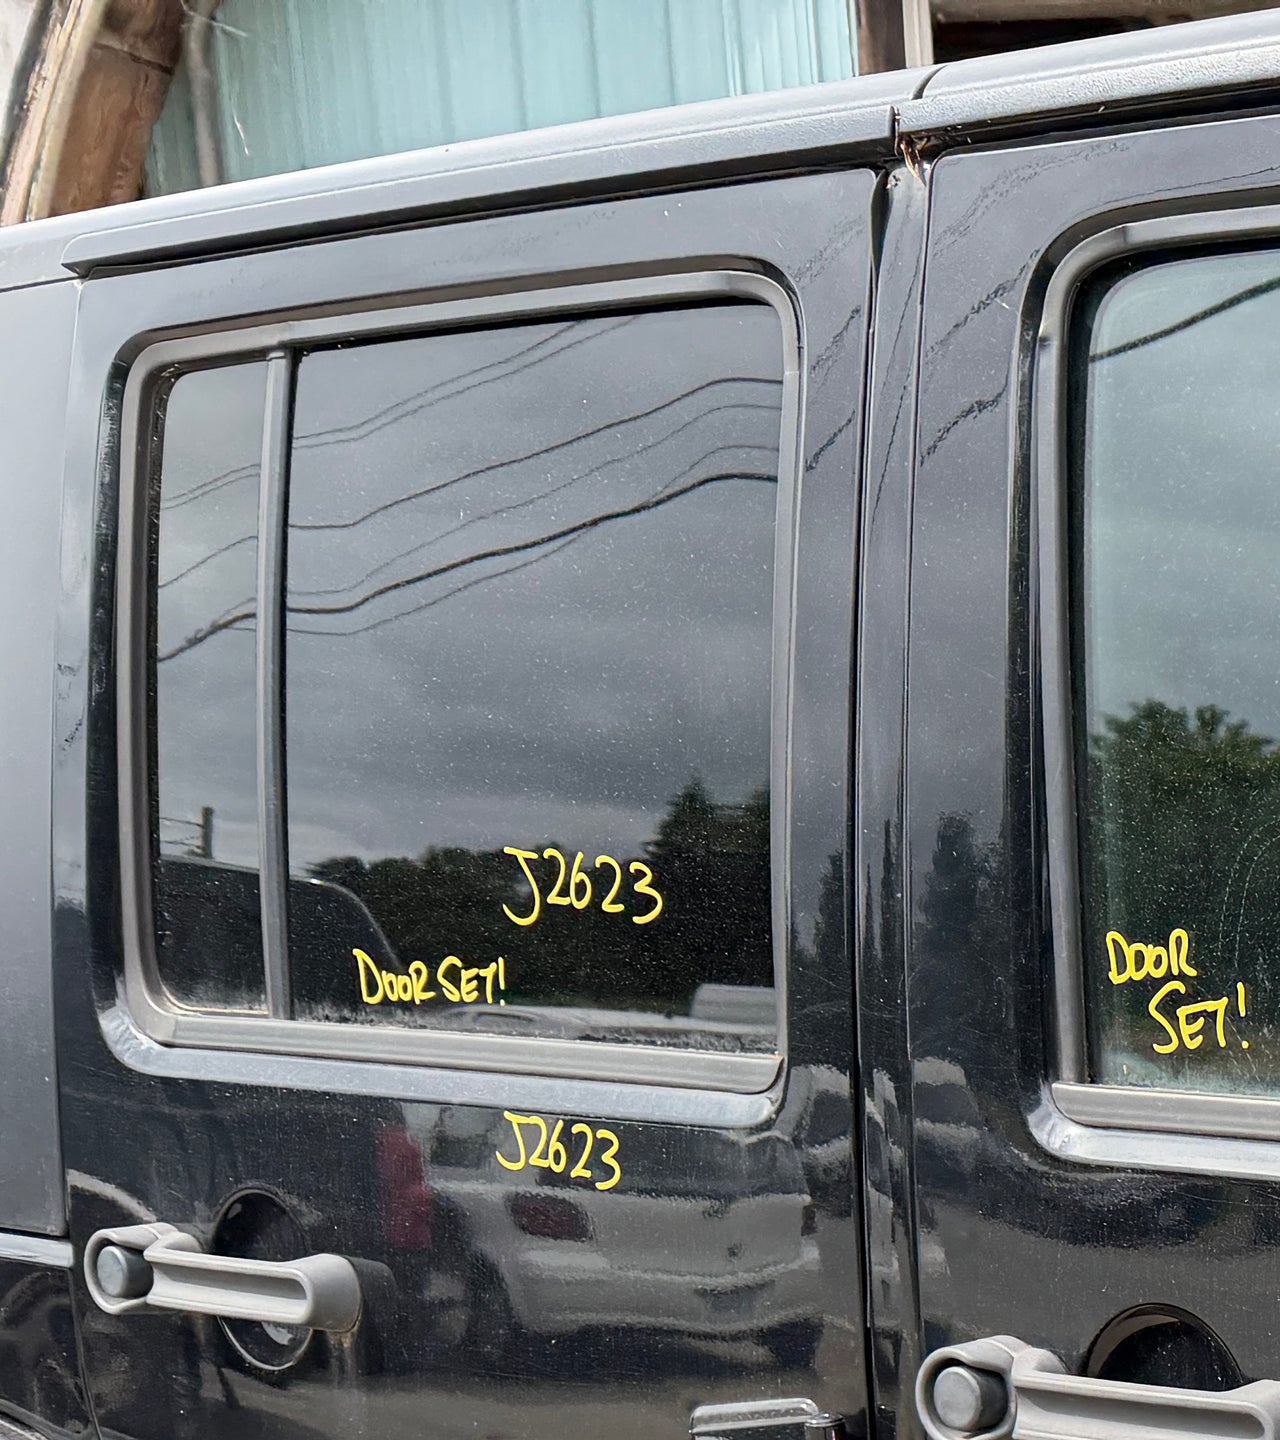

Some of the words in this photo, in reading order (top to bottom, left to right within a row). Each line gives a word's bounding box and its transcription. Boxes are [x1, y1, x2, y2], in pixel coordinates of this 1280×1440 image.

[502, 846, 664, 926] J2623
[352, 950, 438, 1005] DOOR
[436, 957, 507, 1007] SET!
[1106, 929, 1198, 986] DOOR
[1148, 981, 1251, 1055] SET!
[496, 1111, 623, 1191] J2623
